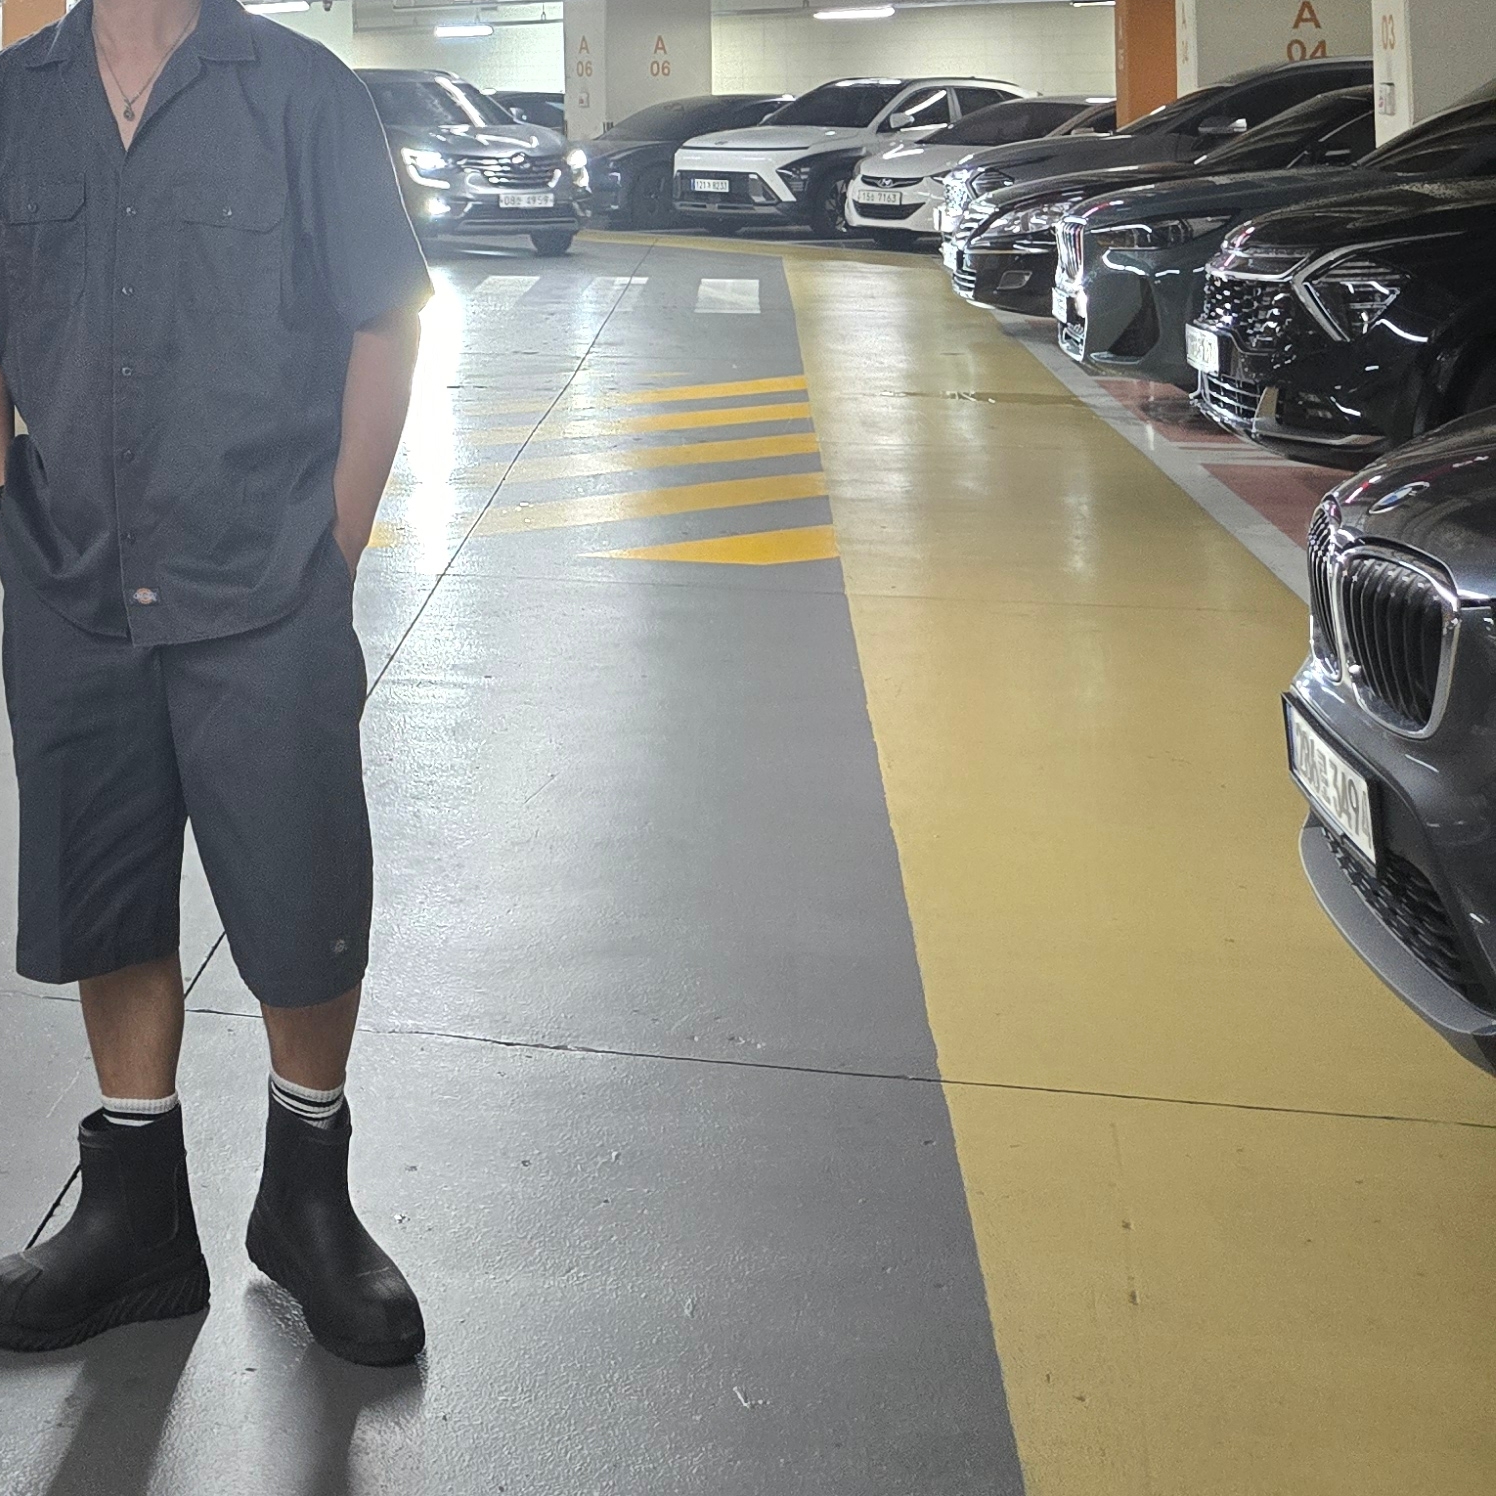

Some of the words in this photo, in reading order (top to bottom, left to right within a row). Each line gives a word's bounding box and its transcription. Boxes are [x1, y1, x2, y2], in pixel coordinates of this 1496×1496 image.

[1292, 0, 1322, 29] A
[1381, 14, 1396, 50] 03
[578, 35, 590, 54] A
[653, 35, 668, 54] A
[1287, 39, 1329, 62] 04
[576, 60, 593, 77] 06
[650, 60, 671, 77] 06
